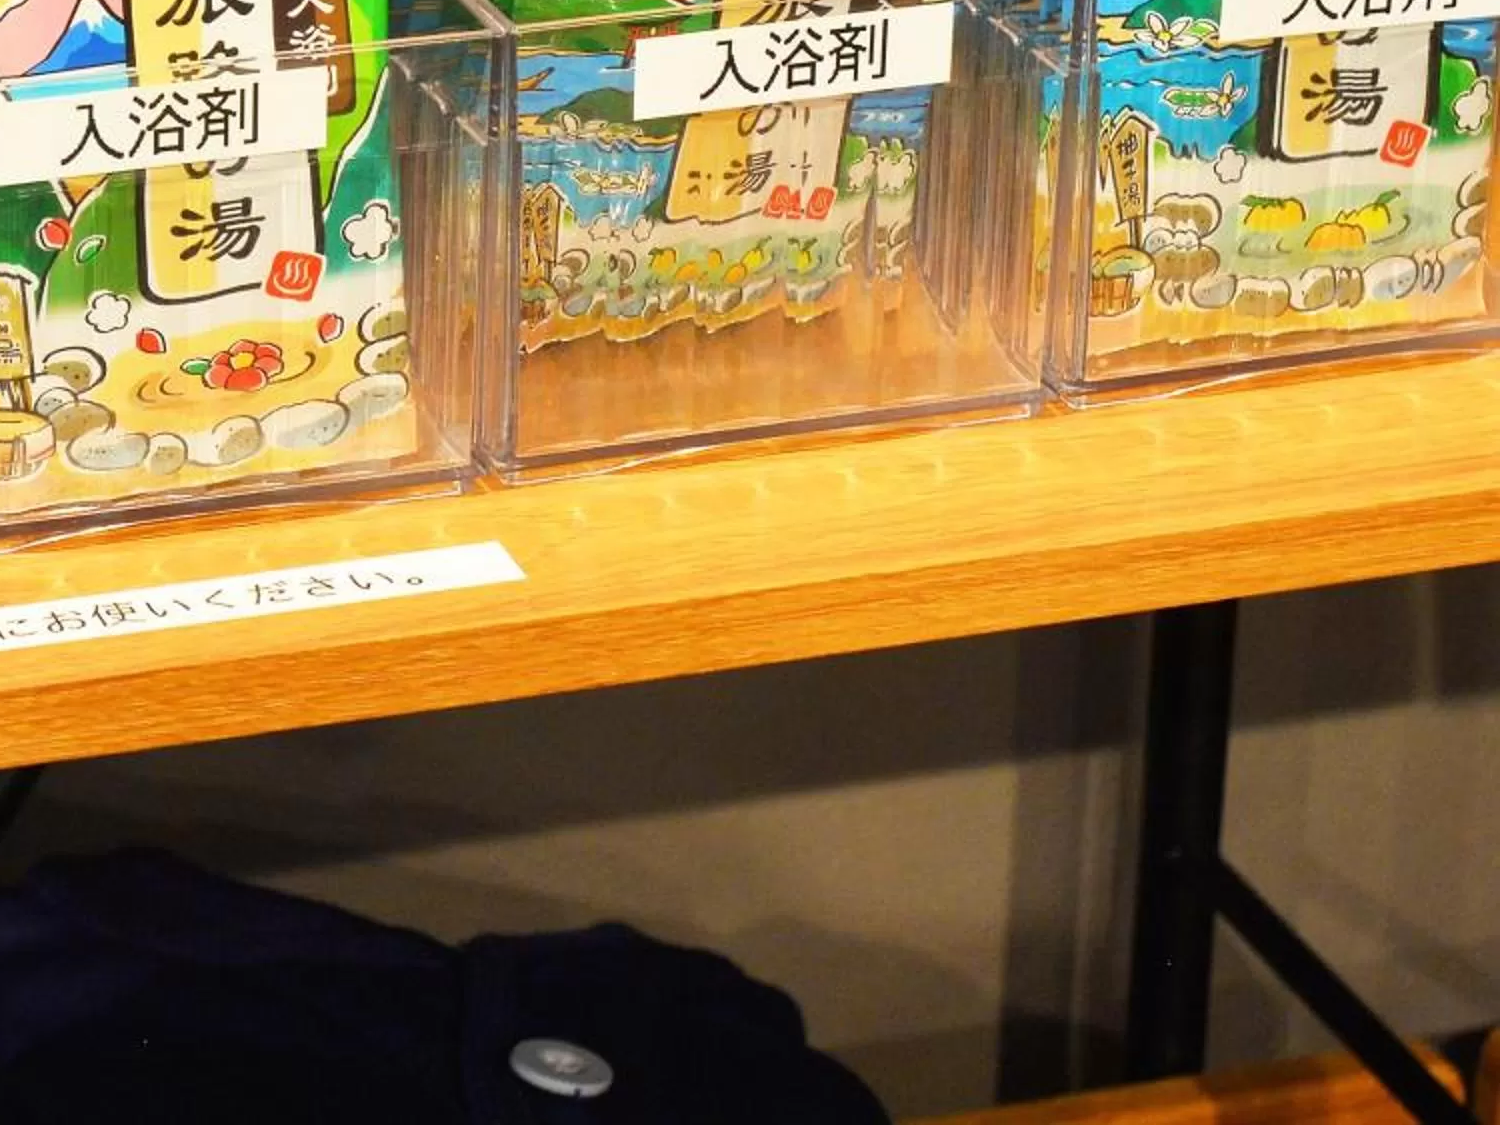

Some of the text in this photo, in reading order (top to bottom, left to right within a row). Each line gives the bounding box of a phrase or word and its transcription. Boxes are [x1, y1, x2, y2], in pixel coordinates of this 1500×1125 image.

[700, 18, 890, 101] 入浴剤
[60, 81, 260, 165] 入浴剤
